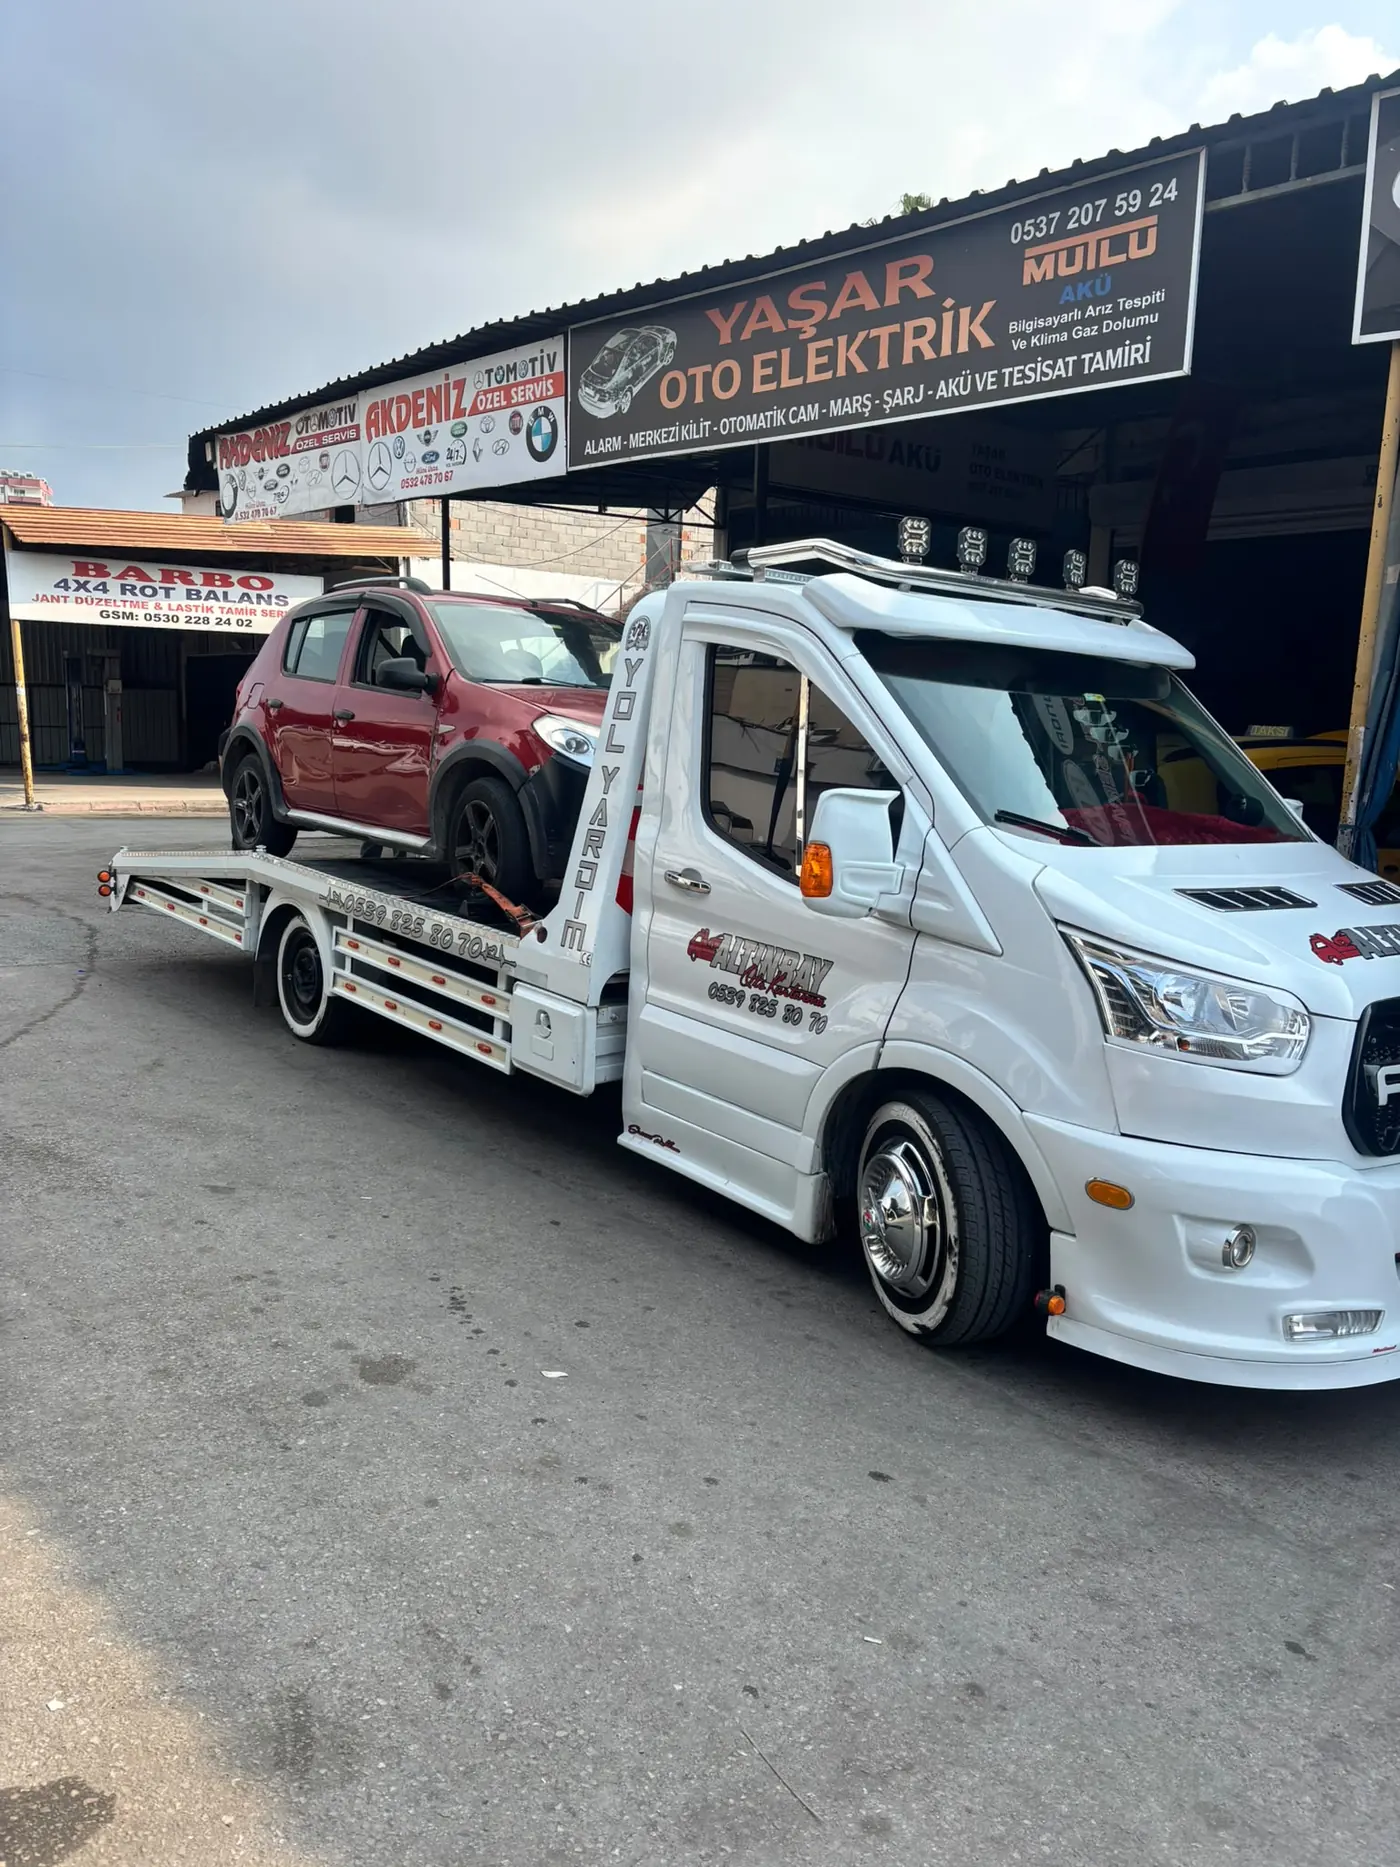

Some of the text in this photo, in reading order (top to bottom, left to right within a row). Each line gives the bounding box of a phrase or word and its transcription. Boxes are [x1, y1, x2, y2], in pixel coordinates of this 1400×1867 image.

[1011, 178, 1178, 244] 0537 207 59 24
[1022, 214, 1158, 286] MUTLU
[705, 254, 936, 345] YAŞAR
[1009, 308, 1081, 334] Bilgisayarlı
[1117, 289, 1165, 311] Tespiti
[1059, 273, 1112, 304] AKÜ
[659, 297, 997, 409] OTO ELEKTRİK
[1012, 312, 1159, 351] Ve Klima Gaz Dolumu
[365, 373, 467, 444] AKDENİZ
[477, 378, 554, 411] ÖZEL SERVİS
[584, 436, 622, 455] ALARM
[629, 421, 679, 448] MERKEZİ
[681, 419, 711, 441] KİLİT
[719, 406, 786, 435] OTOMATİK
[789, 402, 818, 424] CAM
[829, 394, 872, 417] MARŞ
[882, 384, 925, 415] ŞARJ
[935, 370, 971, 400] AKÜ
[975, 369, 998, 392] VE
[1001, 355, 1078, 388] TESİSAT
[1081, 336, 1152, 375] TAMİRİ
[401, 470, 454, 489] 0532 478 70 67
[53, 577, 289, 607] 4X4 ROT BALANS
[71, 560, 274, 592] BARBO
[31, 592, 71, 605] JANT
[74, 594, 150, 610] DÜZELTME
[154, 602, 163, 611] &
[167, 602, 215, 615] LASTİK
[218, 604, 257, 617] TAMİR
[99, 609, 253, 629] GSM: 0530 228 24 02
[560, 658, 644, 952] YOL YARDIM
[343, 894, 482, 959] 0539 825 80 70
[710, 932, 834, 995] ALTINBAY
[708, 981, 828, 1034] 0539 825 80 70
